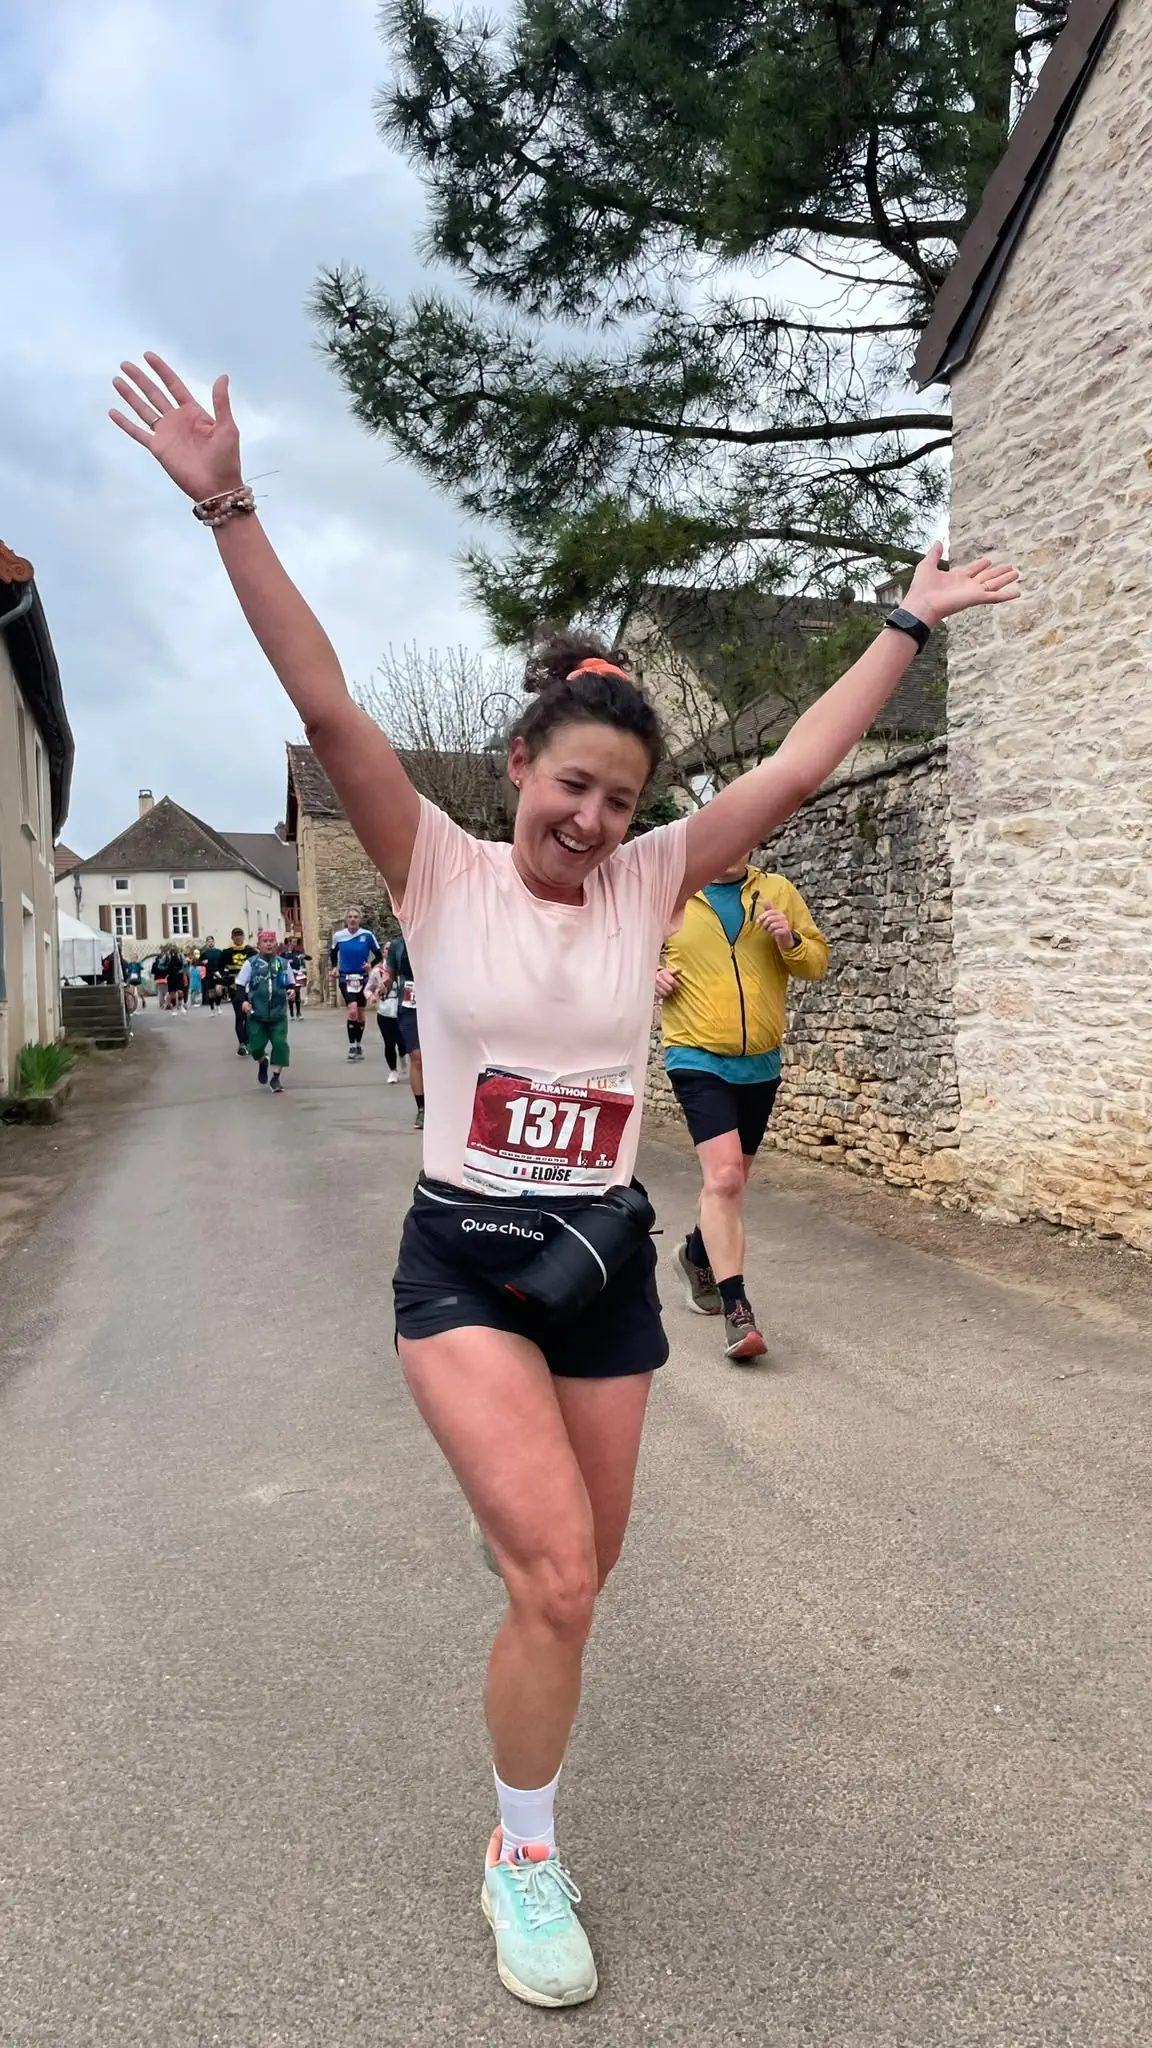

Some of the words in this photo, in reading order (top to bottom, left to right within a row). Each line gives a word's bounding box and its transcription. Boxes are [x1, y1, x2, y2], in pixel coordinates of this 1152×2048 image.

[530, 1082, 588, 1098] MARATHON
[505, 1096, 602, 1152] 1371
[531, 1166, 572, 1182] ELOÏSE
[461, 1218, 544, 1241] Quechua
